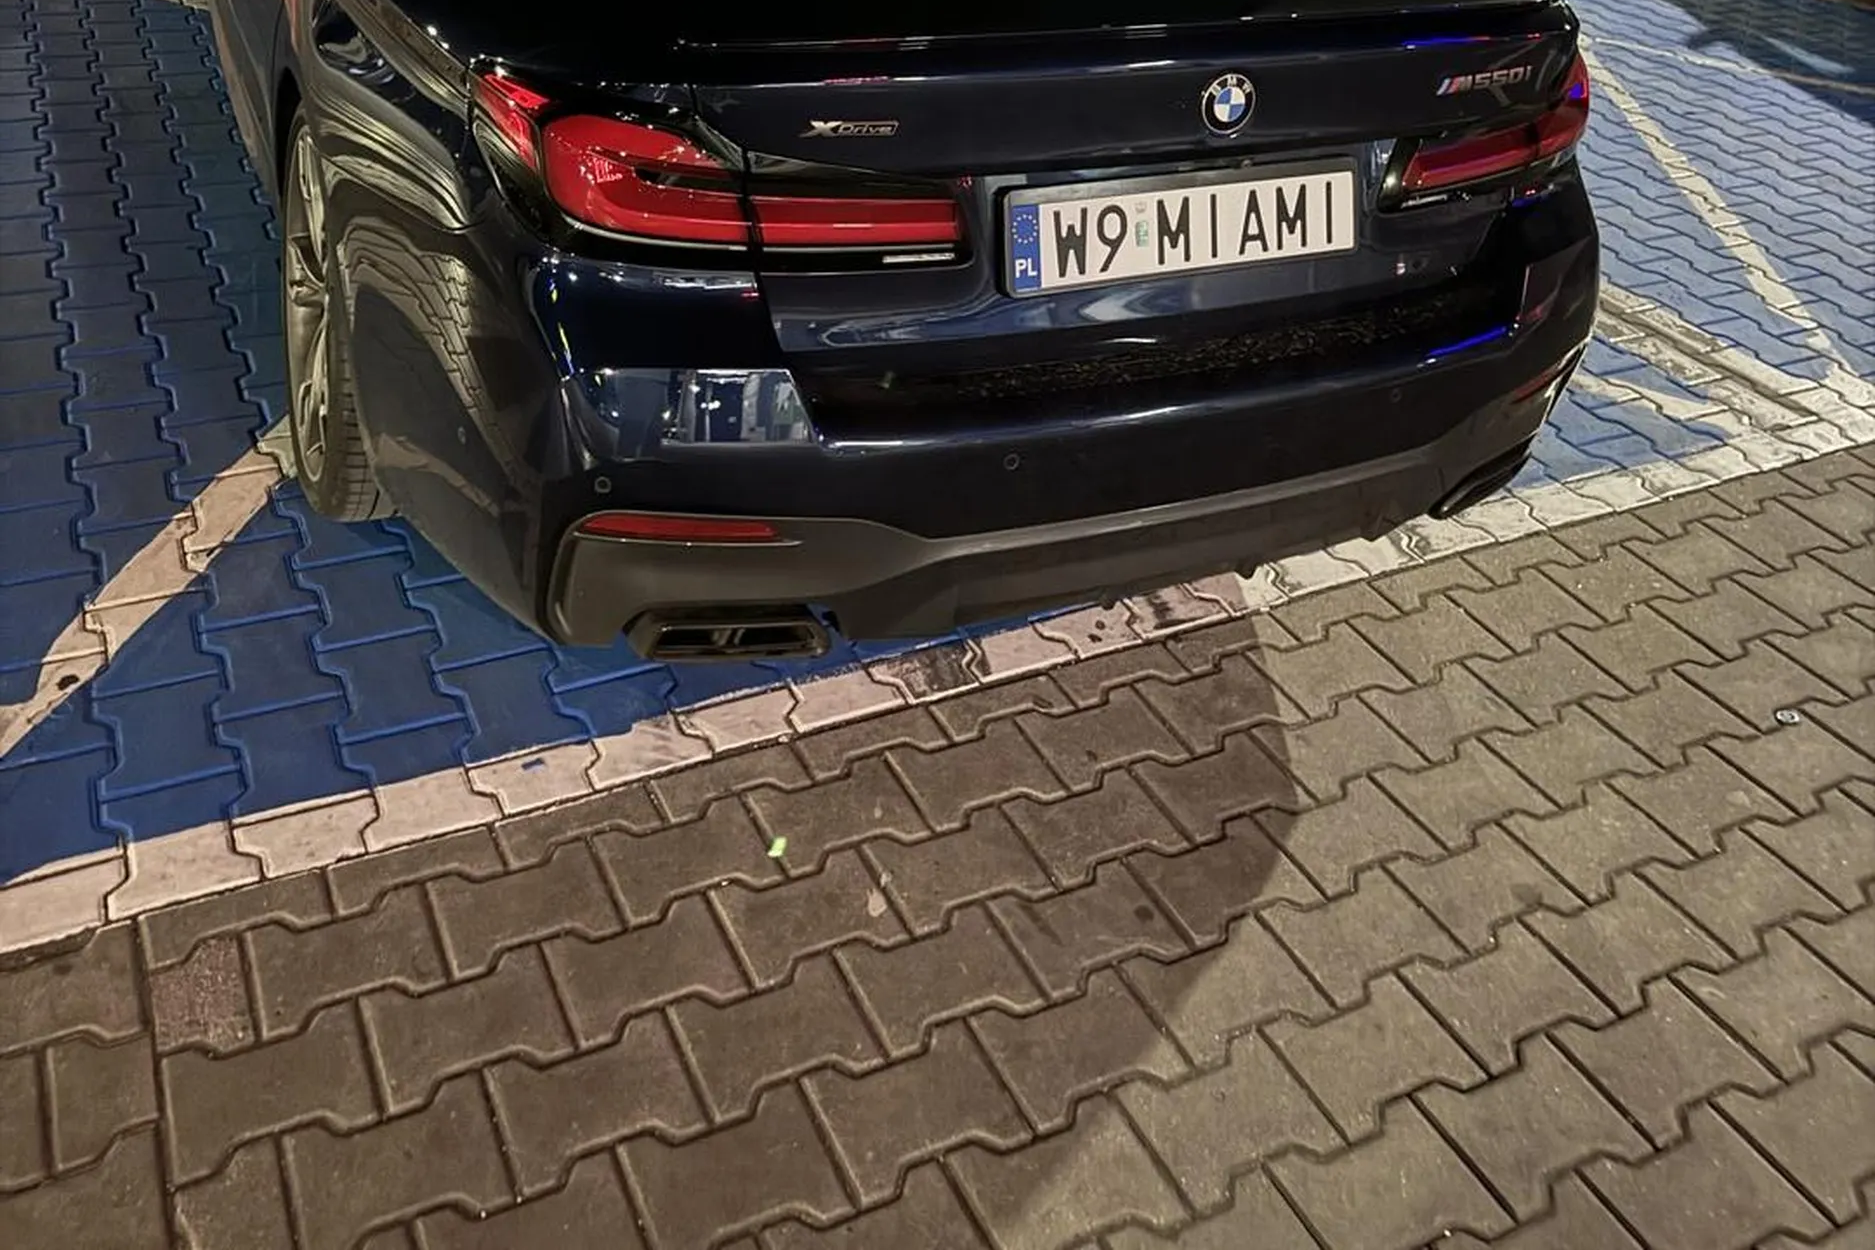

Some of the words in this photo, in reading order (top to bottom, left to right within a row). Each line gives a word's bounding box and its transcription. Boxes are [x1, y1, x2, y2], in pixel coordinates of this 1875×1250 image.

[1053, 204, 1128, 278] W9
[1156, 181, 1332, 265] MIAMI
[1014, 258, 1039, 280] PL
